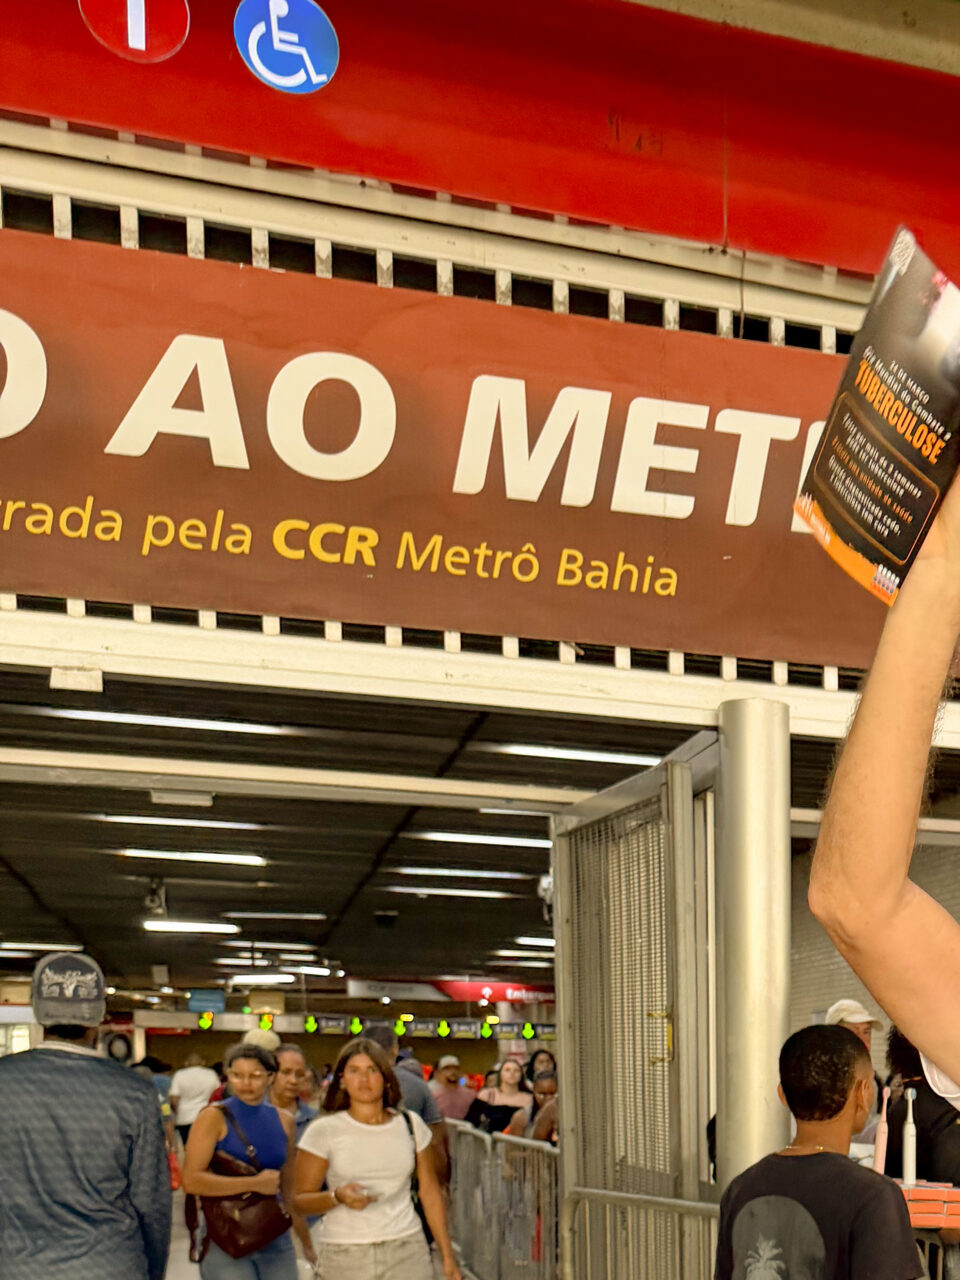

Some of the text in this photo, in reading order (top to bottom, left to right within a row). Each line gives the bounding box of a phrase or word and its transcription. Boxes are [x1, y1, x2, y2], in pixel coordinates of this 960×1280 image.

[104, 333, 397, 484] AO
[854, 358, 946, 465] TUBERCULOSE
[910, 398, 945, 436] Combate
[0, 495, 679, 597] rada pela CCR Metrô Bahia
